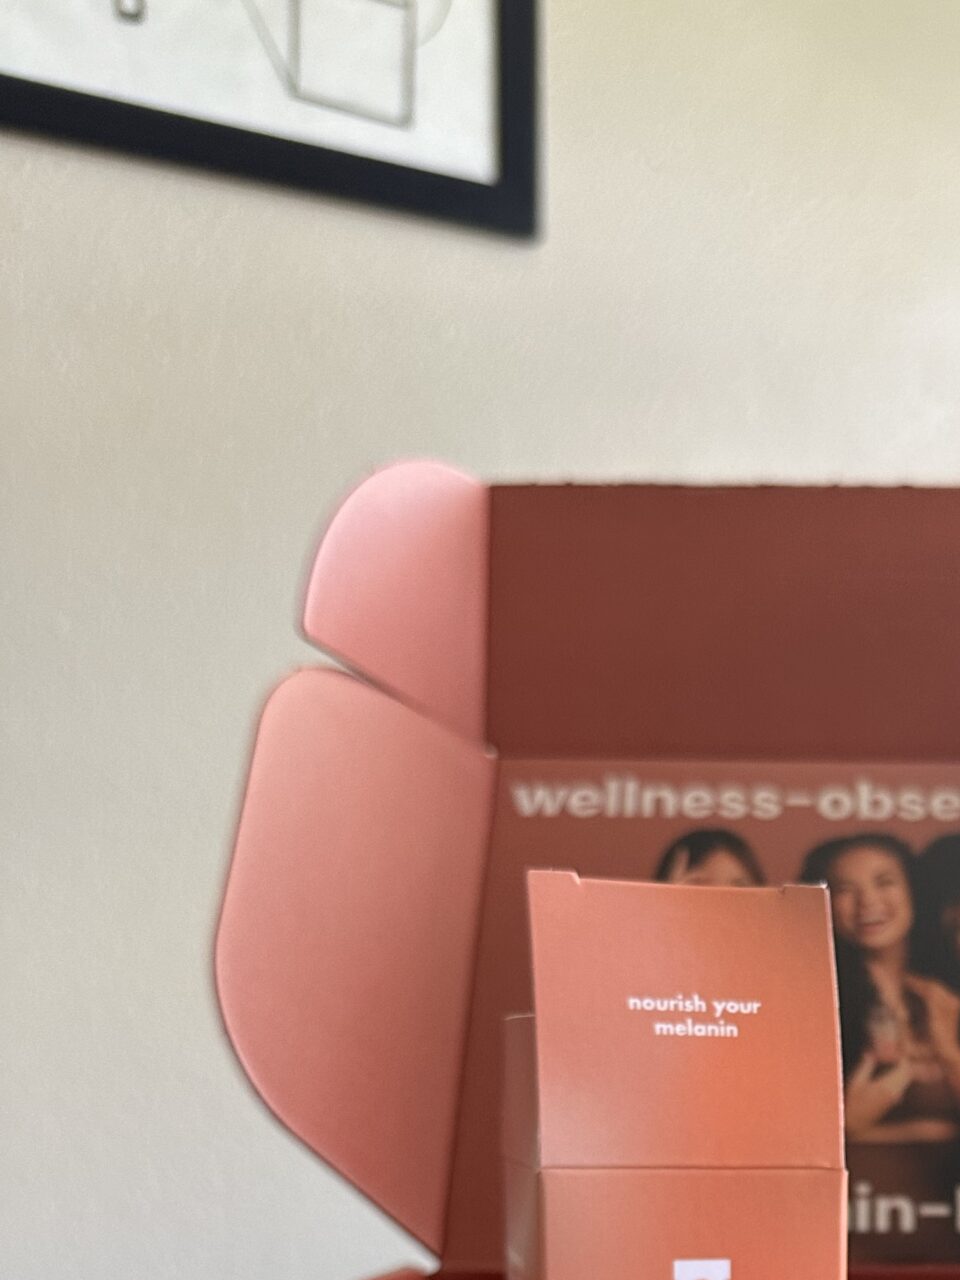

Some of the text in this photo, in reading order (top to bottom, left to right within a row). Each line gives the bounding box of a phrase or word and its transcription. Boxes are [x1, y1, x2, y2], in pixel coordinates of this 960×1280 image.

[628, 994, 761, 1017] nourish your
[654, 1018, 739, 1037] melanin
